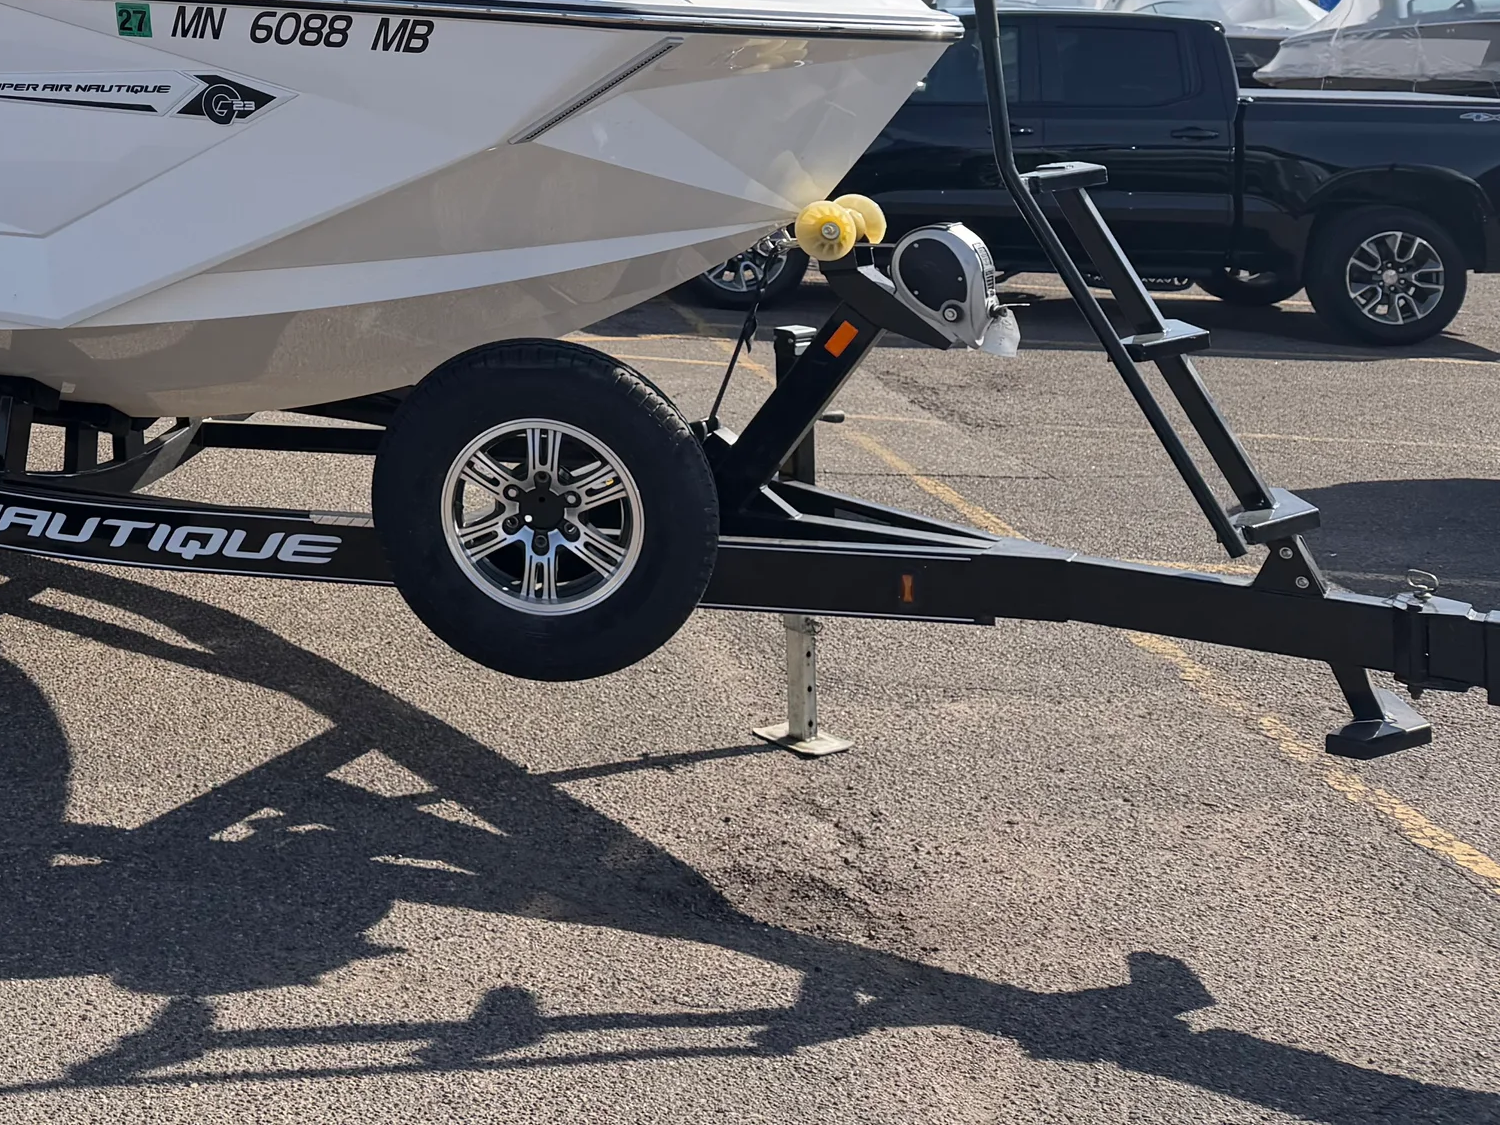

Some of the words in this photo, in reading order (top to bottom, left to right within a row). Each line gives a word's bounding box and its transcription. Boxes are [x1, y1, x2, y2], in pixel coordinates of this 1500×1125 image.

[118, 9, 147, 32] 27
[171, 5, 227, 39] MN
[249, 11, 353, 48] 6088
[370, 17, 435, 53] MB
[41, 83, 73, 93] AIR
[74, 83, 172, 94] NAUTIQUE
